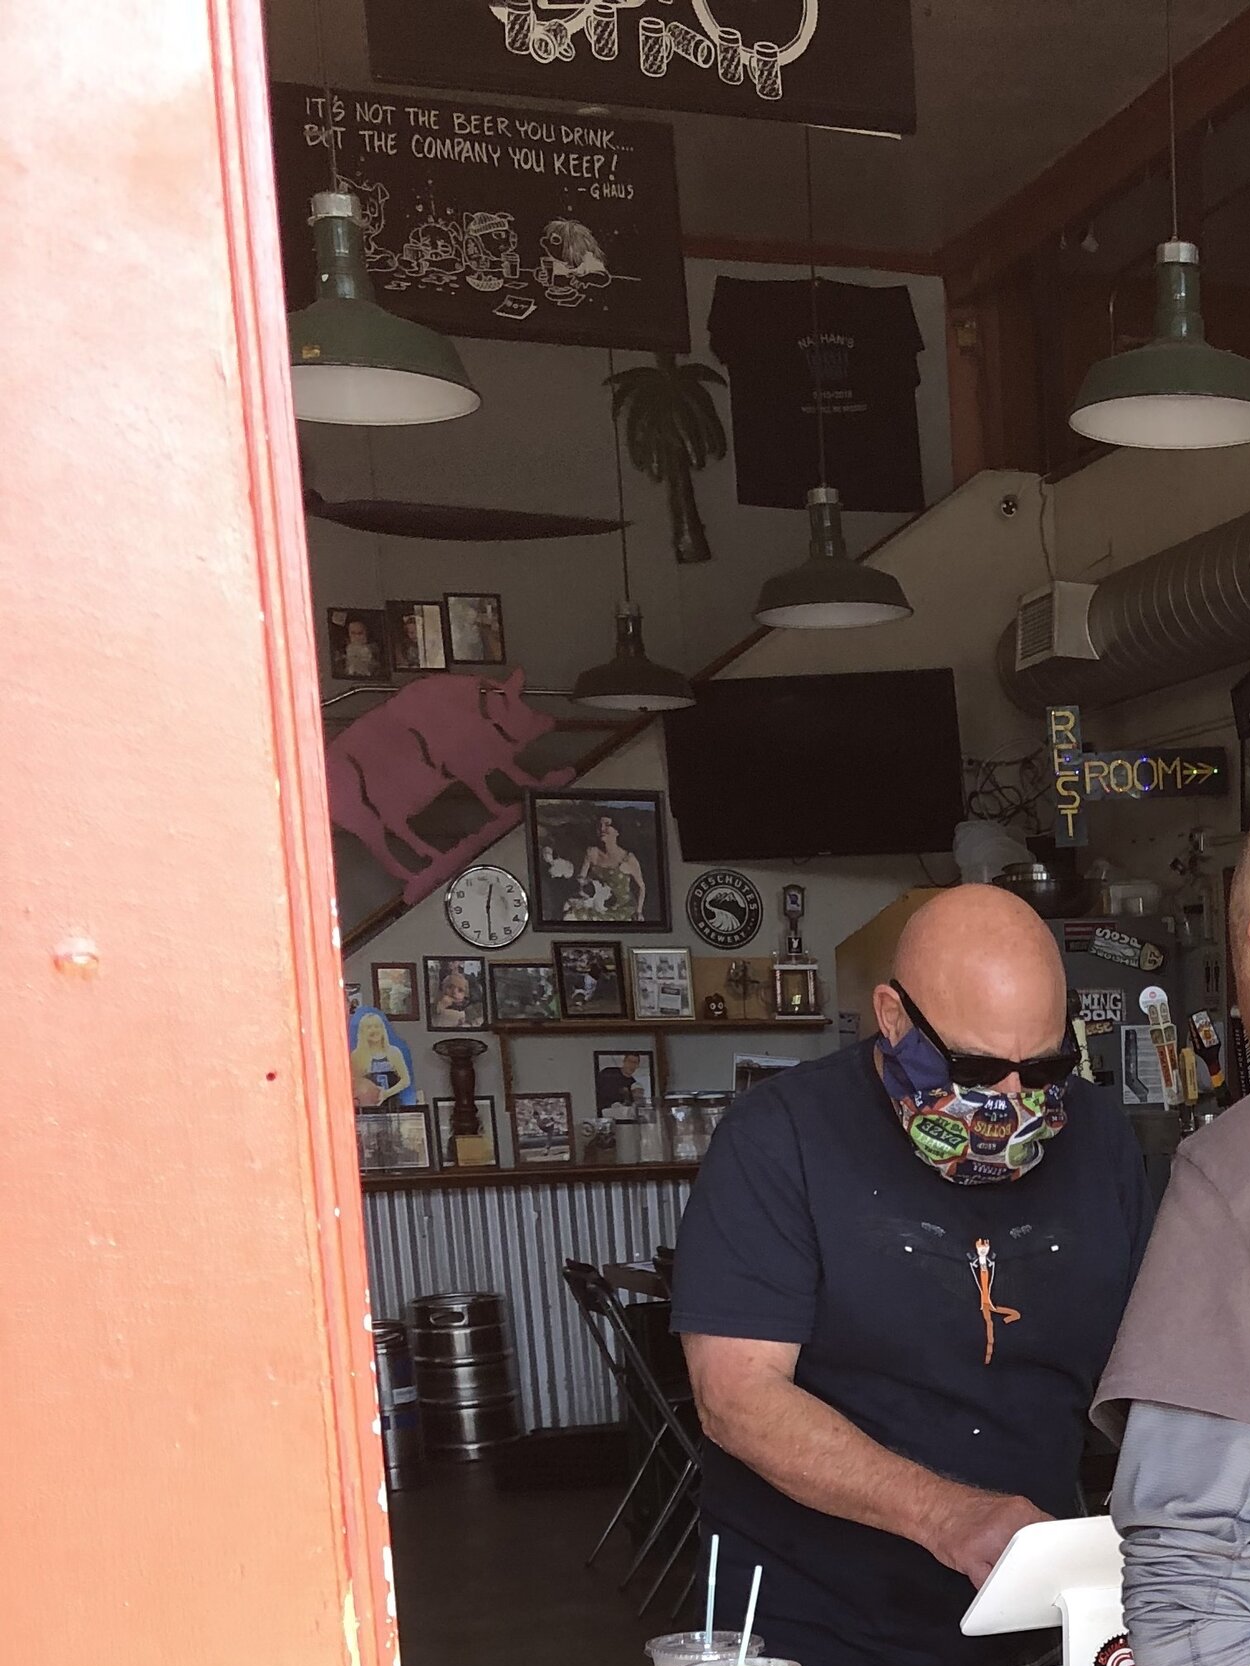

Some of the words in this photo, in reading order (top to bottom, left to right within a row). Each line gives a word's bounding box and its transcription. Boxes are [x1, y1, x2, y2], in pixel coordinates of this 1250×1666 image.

[305, 95, 345, 122] IT'S
[355, 101, 397, 126] NOT
[404, 107, 440, 130] THE
[452, 112, 512, 138] BEER
[515, 119, 556, 143] YOU
[358, 130, 398, 156] THE
[411, 134, 501, 168] COMPANY
[508, 146, 545, 174] YOU
[797, 332, 855, 351] NAHAN'S
[1052, 711, 1081, 838] REST
[1084, 757, 1183, 795] ROOM
[694, 874, 758, 911] DESCHUTES
[698, 920, 747, 944] BREWERY
[1080, 993, 1122, 1010] MING
